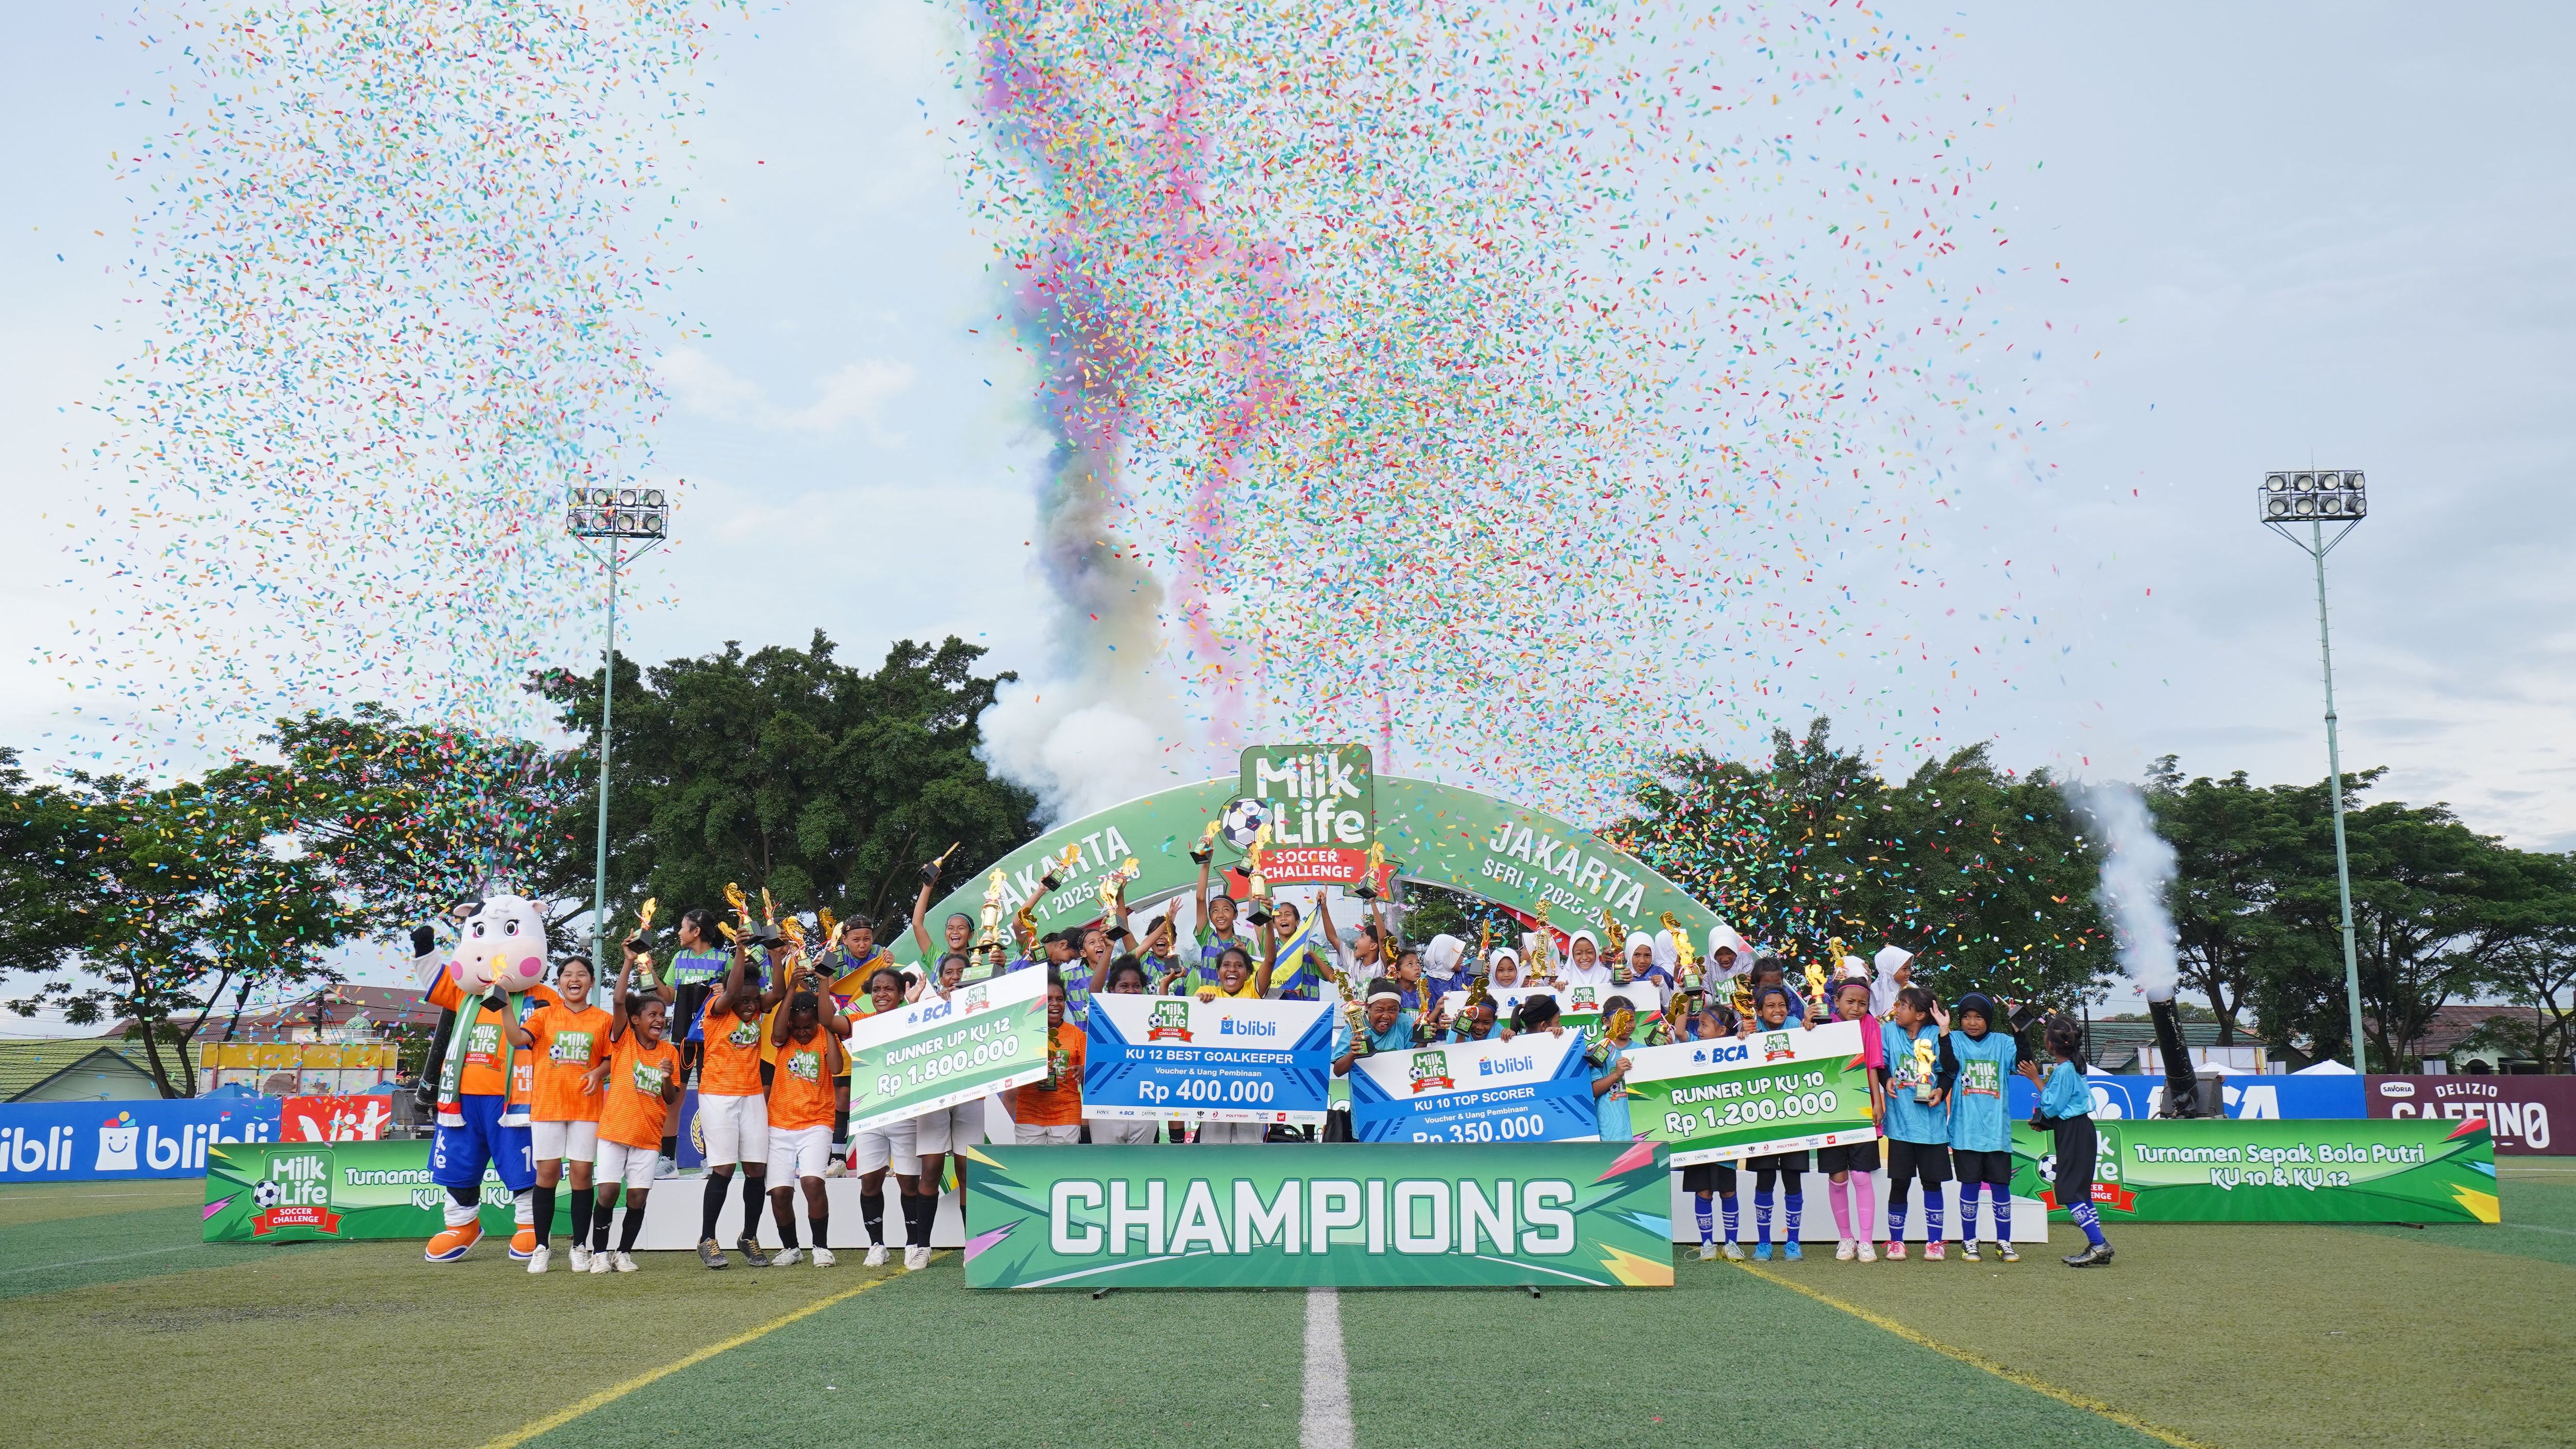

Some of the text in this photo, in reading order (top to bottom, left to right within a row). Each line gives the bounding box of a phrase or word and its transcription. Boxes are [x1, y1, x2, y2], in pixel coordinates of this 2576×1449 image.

[1256, 752, 1362, 799] Milk
[1274, 798, 1365, 844] Life
[1276, 850, 1338, 864] SOCCER
[983, 826, 1132, 922] AKARTA
[1264, 865, 1352, 879] CHALLENGE
[1489, 820, 1645, 919] JAKARTA
[1482, 858, 1630, 936] SERI 1 2025-26
[1038, 904, 1051, 920] 1
[970, 986, 985, 997] Milk
[972, 993, 986, 1003] Life
[1576, 988, 1592, 997] Milk
[923, 1001, 951, 1023] BCA
[1159, 1003, 1186, 1016] Milk
[1162, 1015, 1186, 1027] Life
[1237, 1020, 1276, 1036] blibli
[470, 1026, 497, 1040] Milk
[559, 1033, 589, 1047] Milk
[1769, 1034, 1788, 1044] Milk
[471, 1039, 496, 1053] Life
[886, 1017, 1011, 1067] RUNNER UP KU 12
[1773, 1041, 1789, 1051] Life
[563, 1046, 589, 1060] Life
[1126, 1049, 1294, 1064] KU 12 BEST GOALKEEPER
[1417, 1053, 1443, 1067] Milk
[1712, 1044, 1749, 1063] BCA
[513, 1064, 533, 1078] Mil
[799, 1064, 818, 1078] ife
[877, 1035, 1019, 1096] Rp 1.800.000
[1422, 1063, 1446, 1077] Life
[1494, 1055, 1533, 1074] blibli
[1967, 1062, 1997, 1076] Milk
[636, 1062, 663, 1084] Milk
[1197, 1069, 1217, 1077] Uang
[637, 1075, 662, 1094] Life
[1671, 1071, 1824, 1105] RUNNER UP KU 10
[1972, 1075, 1998, 1090] Life
[2435, 1083, 2498, 1097] DELIZIO
[1139, 1079, 1274, 1104] Rp 400.000
[1415, 1087, 1535, 1111] KU 10 TOP SCORER
[1424, 1115, 1456, 1124] Voucher
[1466, 1111, 1485, 1119] Uang
[1487, 1106, 1528, 1115] Pembinaan
[1665, 1090, 1838, 1137] Rp 1.200.000
[1450, 1114, 1544, 1142] 350.000
[2133, 1143, 2426, 1167] Turnamen Sepak Bola Putri
[273, 1156, 327, 1181] Milk
[2210, 1167, 2351, 1192] KU 10 & KU 12
[280, 1180, 328, 1205] Life
[412, 1189, 439, 1211] KU
[486, 1187, 514, 1209] KU
[272, 1215, 320, 1224] CHALLENGE
[1048, 1177, 1577, 1257] CHAMPIONS
